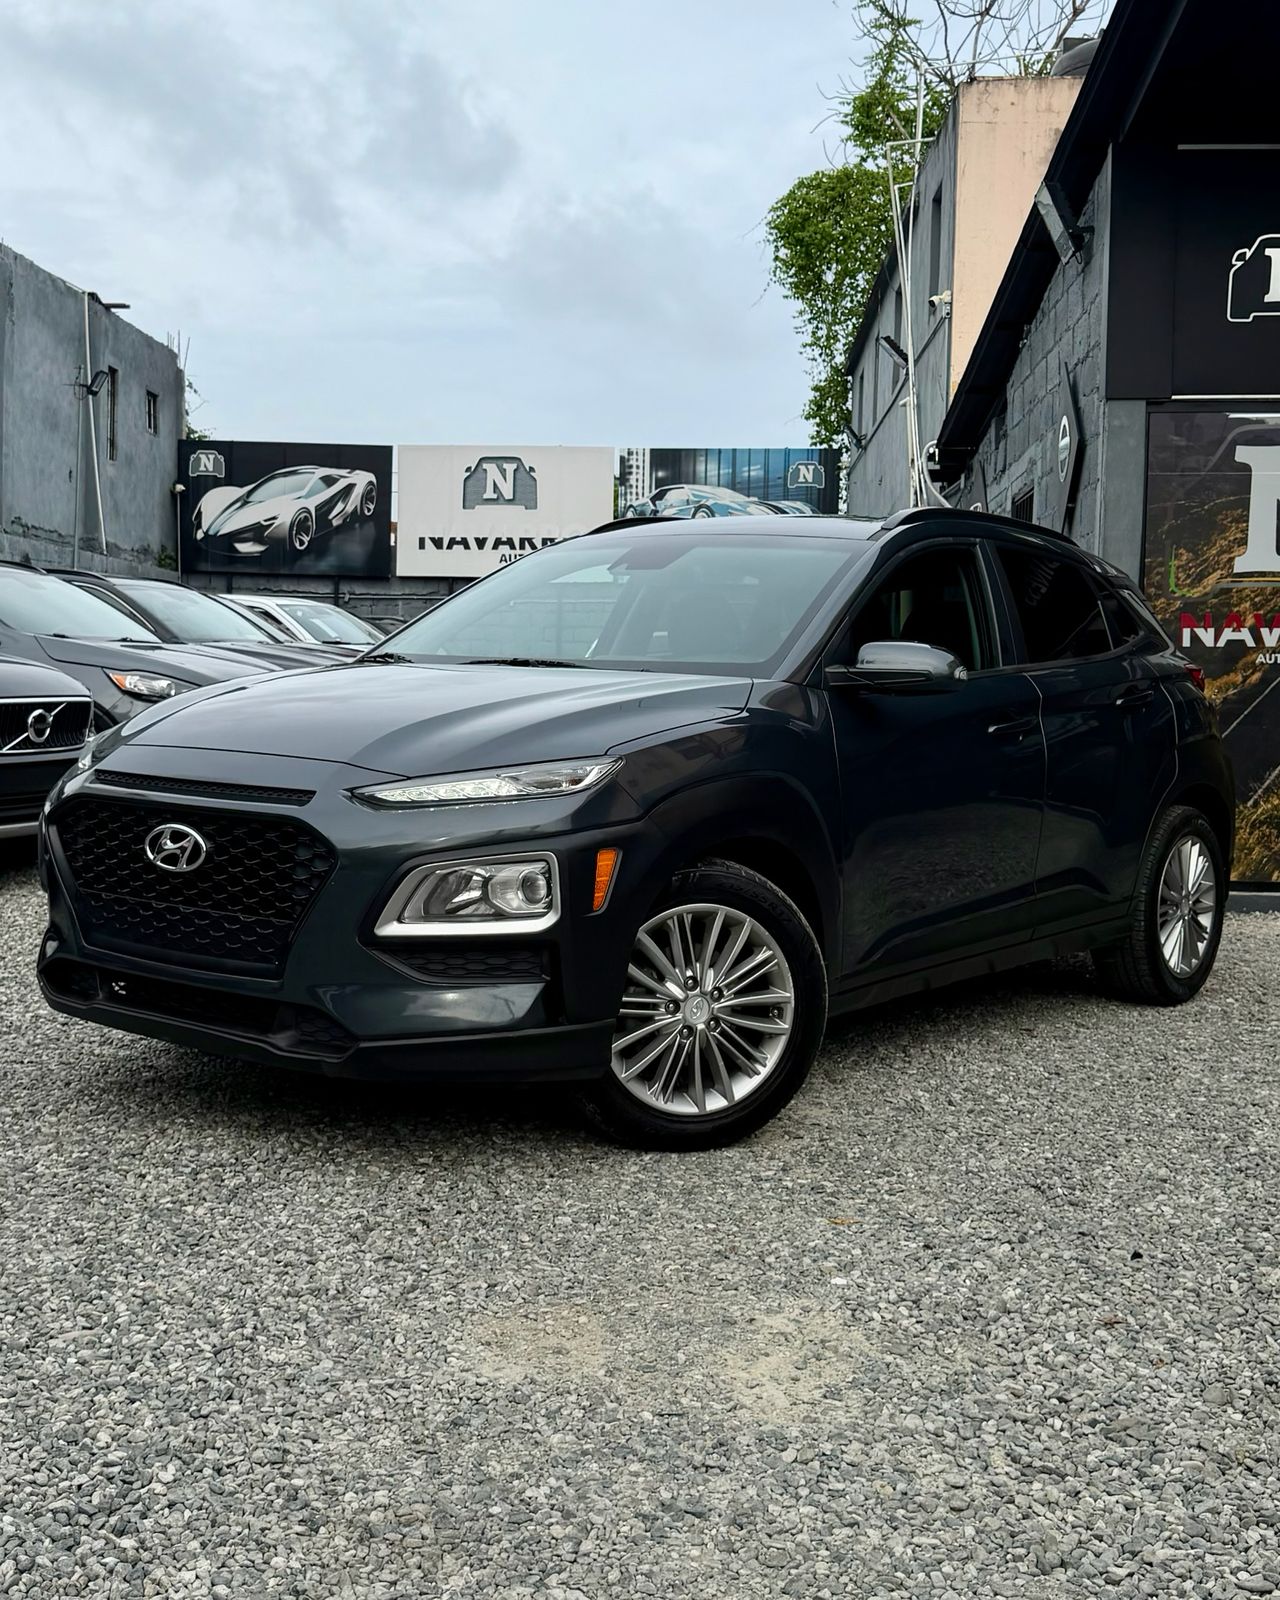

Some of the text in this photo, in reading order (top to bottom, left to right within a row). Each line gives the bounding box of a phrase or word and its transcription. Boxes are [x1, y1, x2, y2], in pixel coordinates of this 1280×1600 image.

[198, 454, 216, 472] N
[482, 463, 517, 500] N
[797, 464, 816, 483] N
